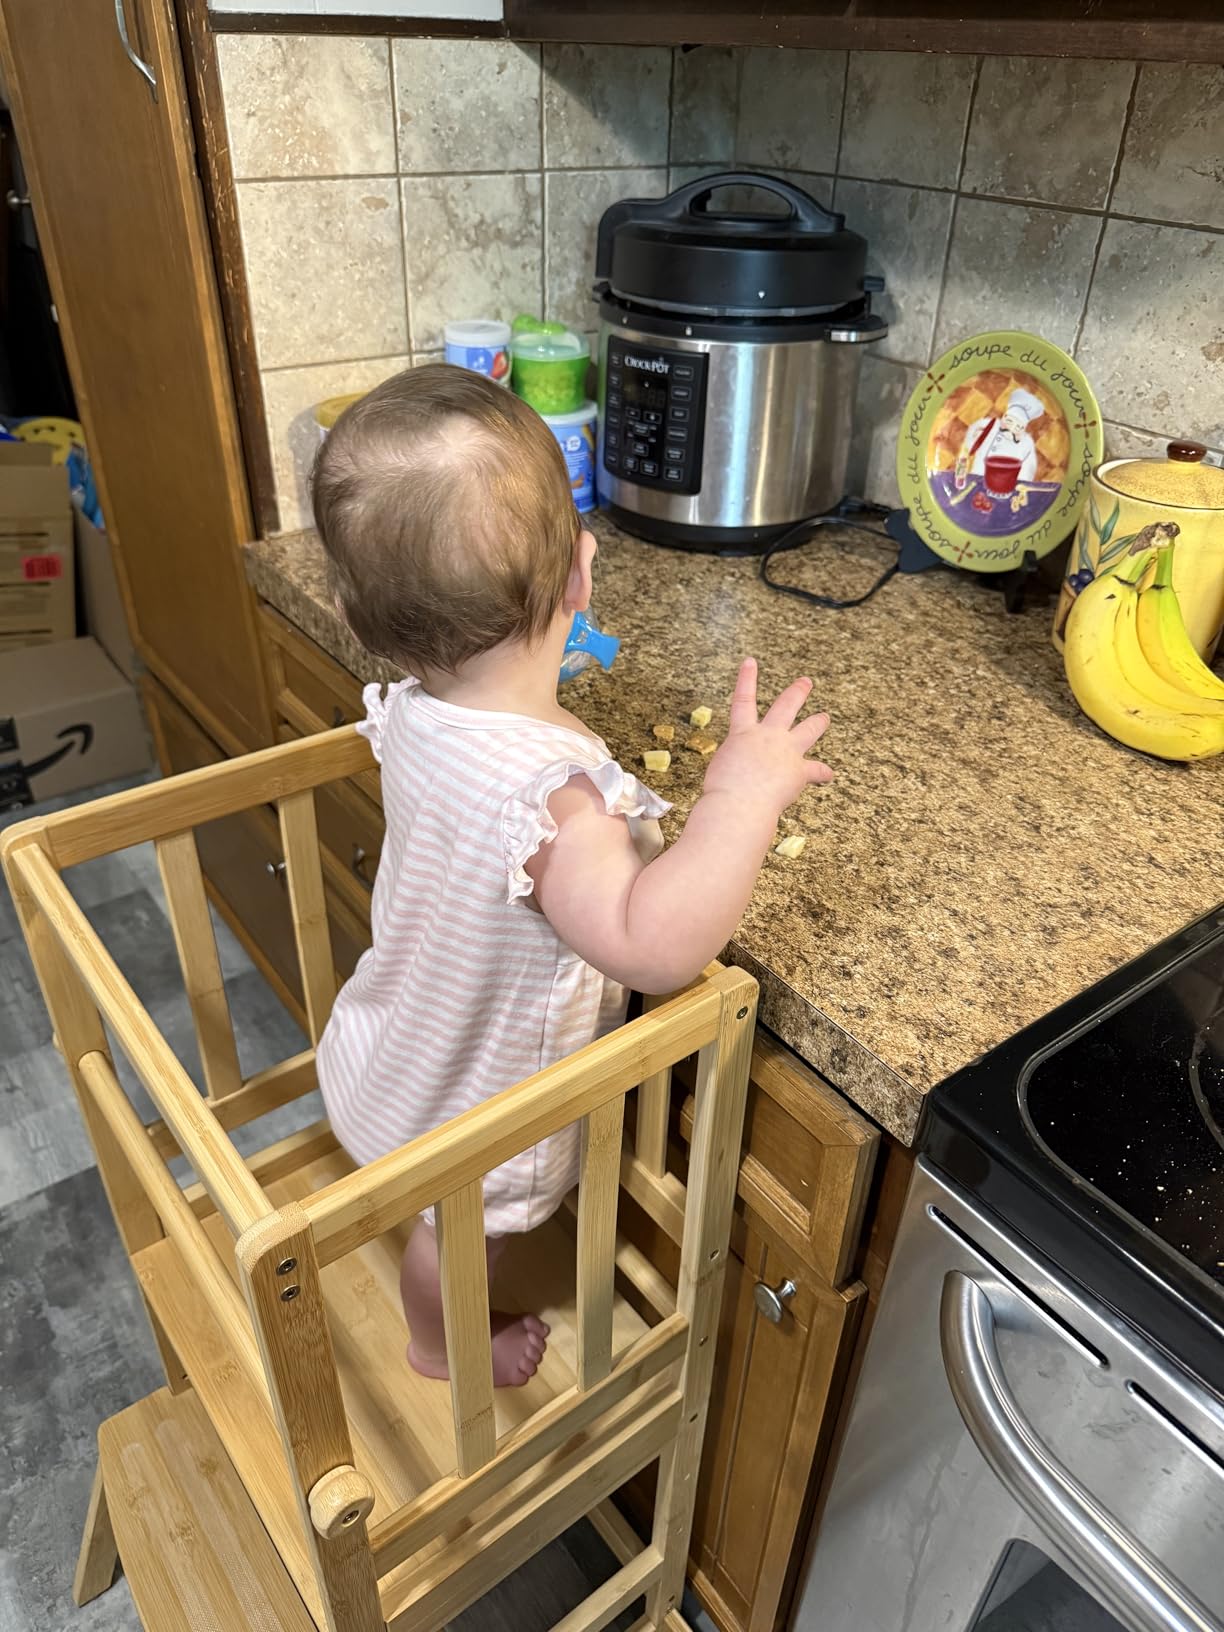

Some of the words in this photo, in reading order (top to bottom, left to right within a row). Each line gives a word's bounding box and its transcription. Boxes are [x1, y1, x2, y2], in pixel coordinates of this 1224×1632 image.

[949, 344, 1014, 370] soupe
[1020, 350, 1047, 371] du
[1050, 367, 1084, 418] jour
[905, 395, 931, 447] jour
[907, 455, 920, 484] du
[1056, 443, 1093, 517] soupe
[913, 492, 953, 548] soupe
[1026, 520, 1052, 544] du
[973, 540, 1020, 560] jour
